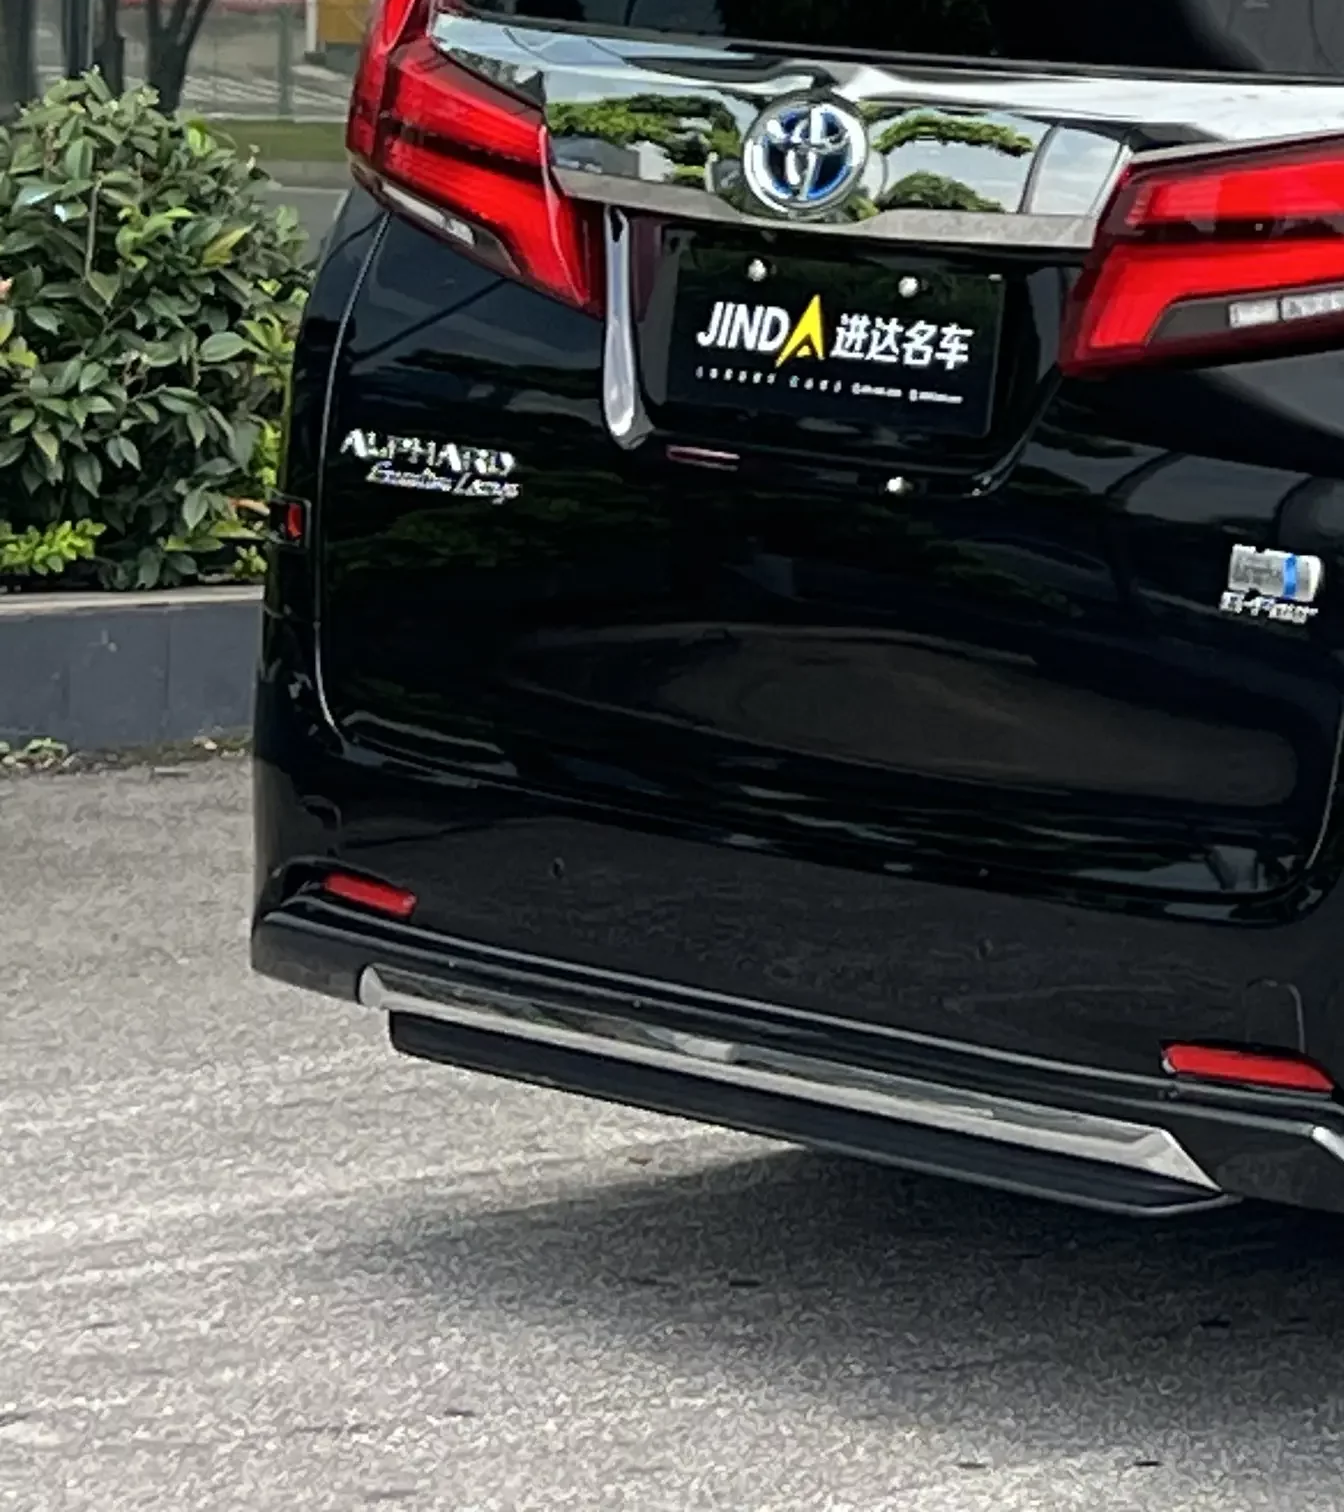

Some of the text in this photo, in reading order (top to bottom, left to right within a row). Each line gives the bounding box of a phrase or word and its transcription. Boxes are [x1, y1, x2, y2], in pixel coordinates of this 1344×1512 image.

[696, 294, 974, 370] JINDA 进达名车
[340, 428, 516, 477] ALPHARD
